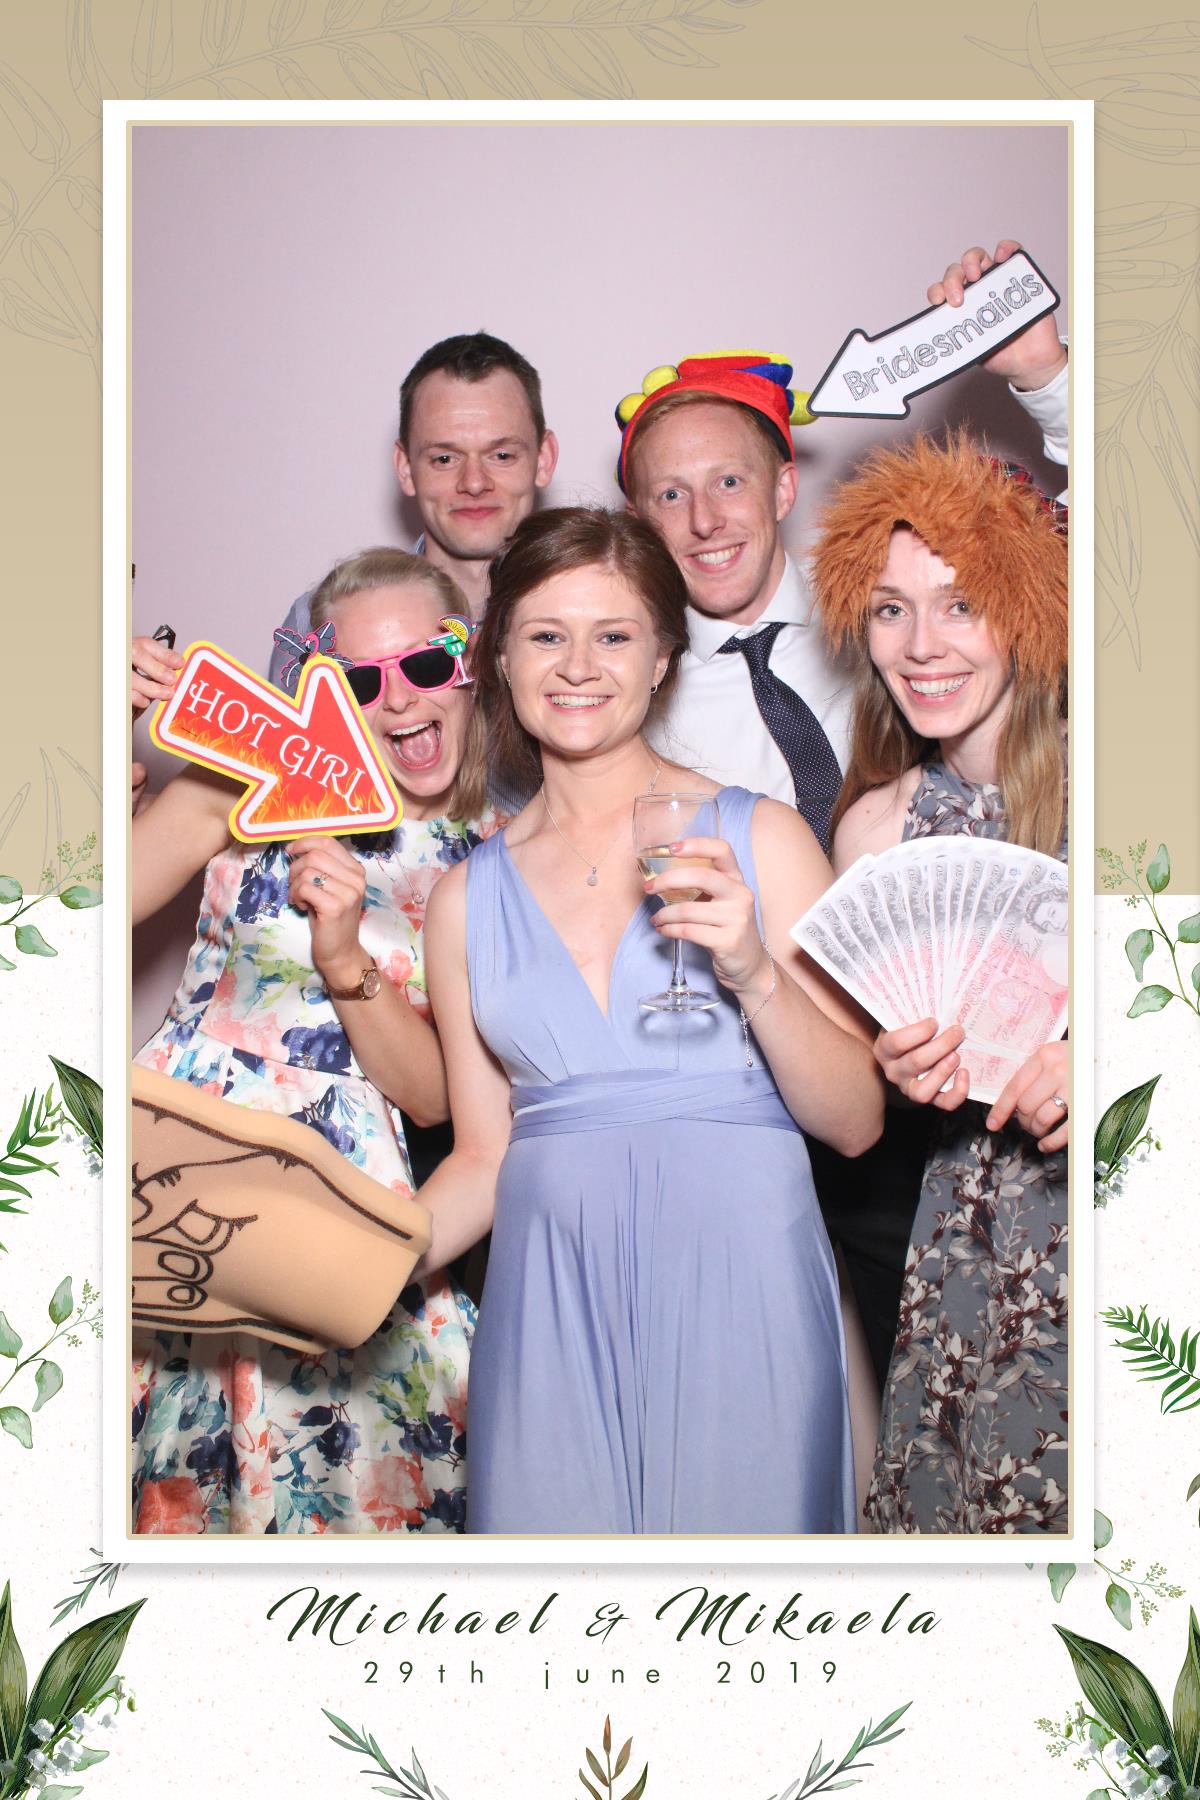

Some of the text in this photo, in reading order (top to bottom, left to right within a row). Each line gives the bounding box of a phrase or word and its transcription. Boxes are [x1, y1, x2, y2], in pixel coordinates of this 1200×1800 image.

[843, 274, 1044, 401] Bridesmaids
[186, 680, 366, 813] HOT GIRL
